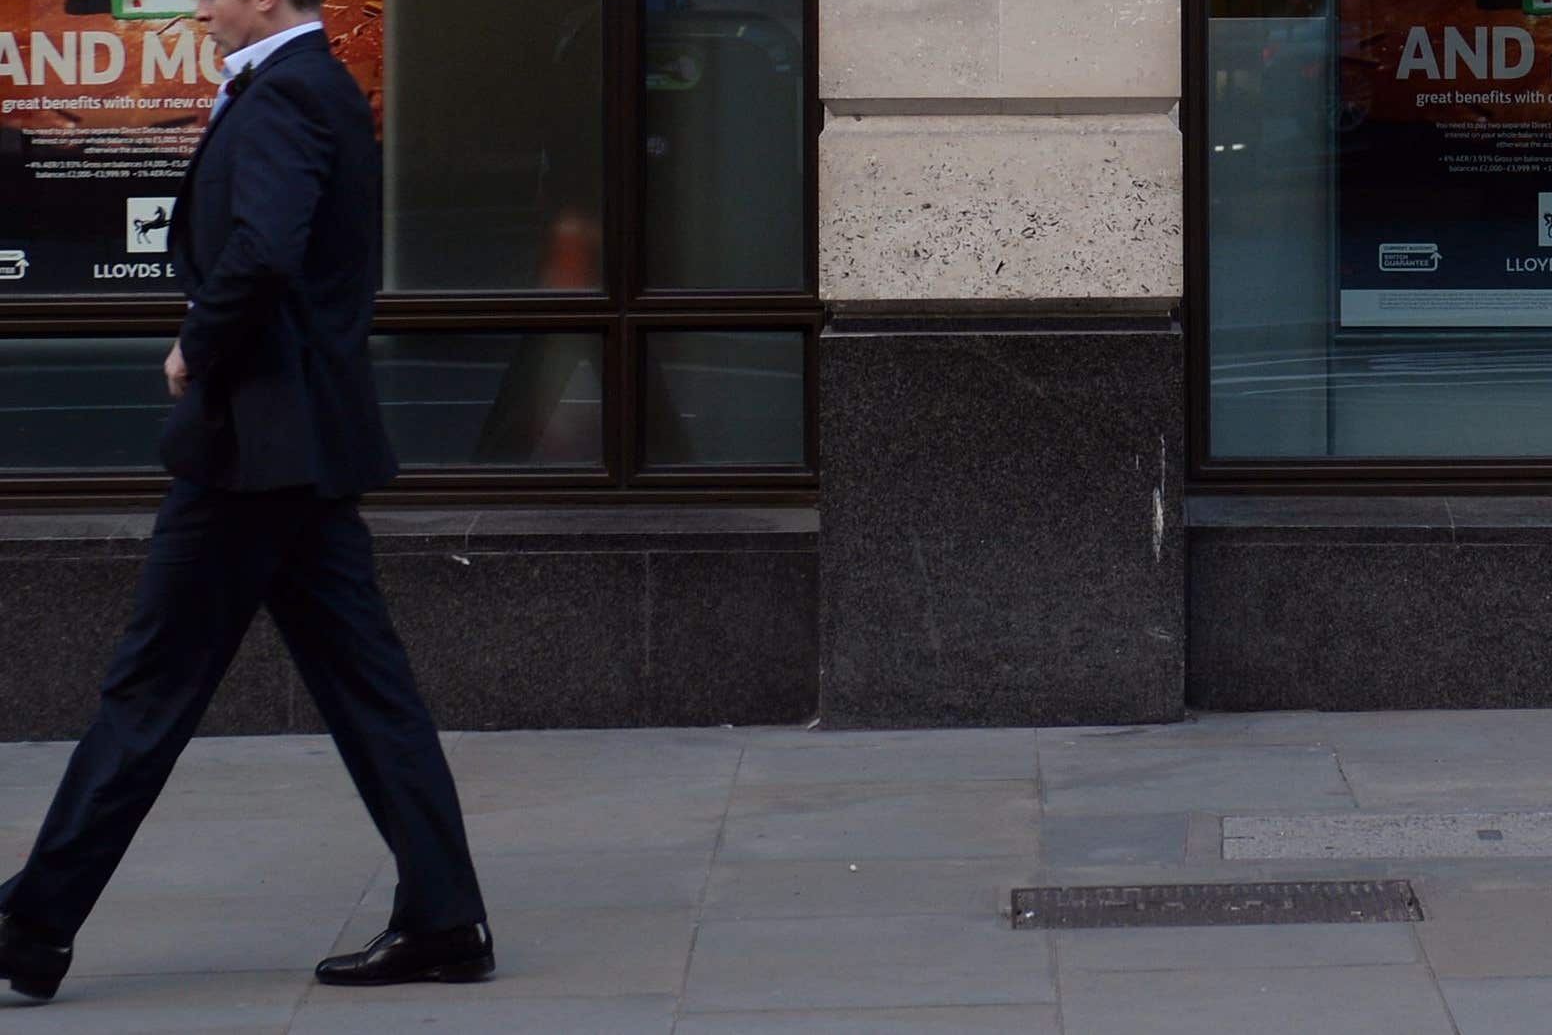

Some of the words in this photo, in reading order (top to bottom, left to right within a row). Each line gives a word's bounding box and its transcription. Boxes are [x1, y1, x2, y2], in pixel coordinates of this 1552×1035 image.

[0, 31, 125, 85] AND
[1396, 25, 1534, 80] AND
[2, 98, 40, 113] great
[41, 96, 102, 110] benefits
[104, 96, 135, 110] with
[137, 100, 161, 110] our
[164, 100, 193, 110] new
[1415, 92, 1452, 108] great
[1454, 90, 1511, 105] benefits
[1514, 90, 1545, 105] with
[94, 265, 160, 279] LLOYDS
